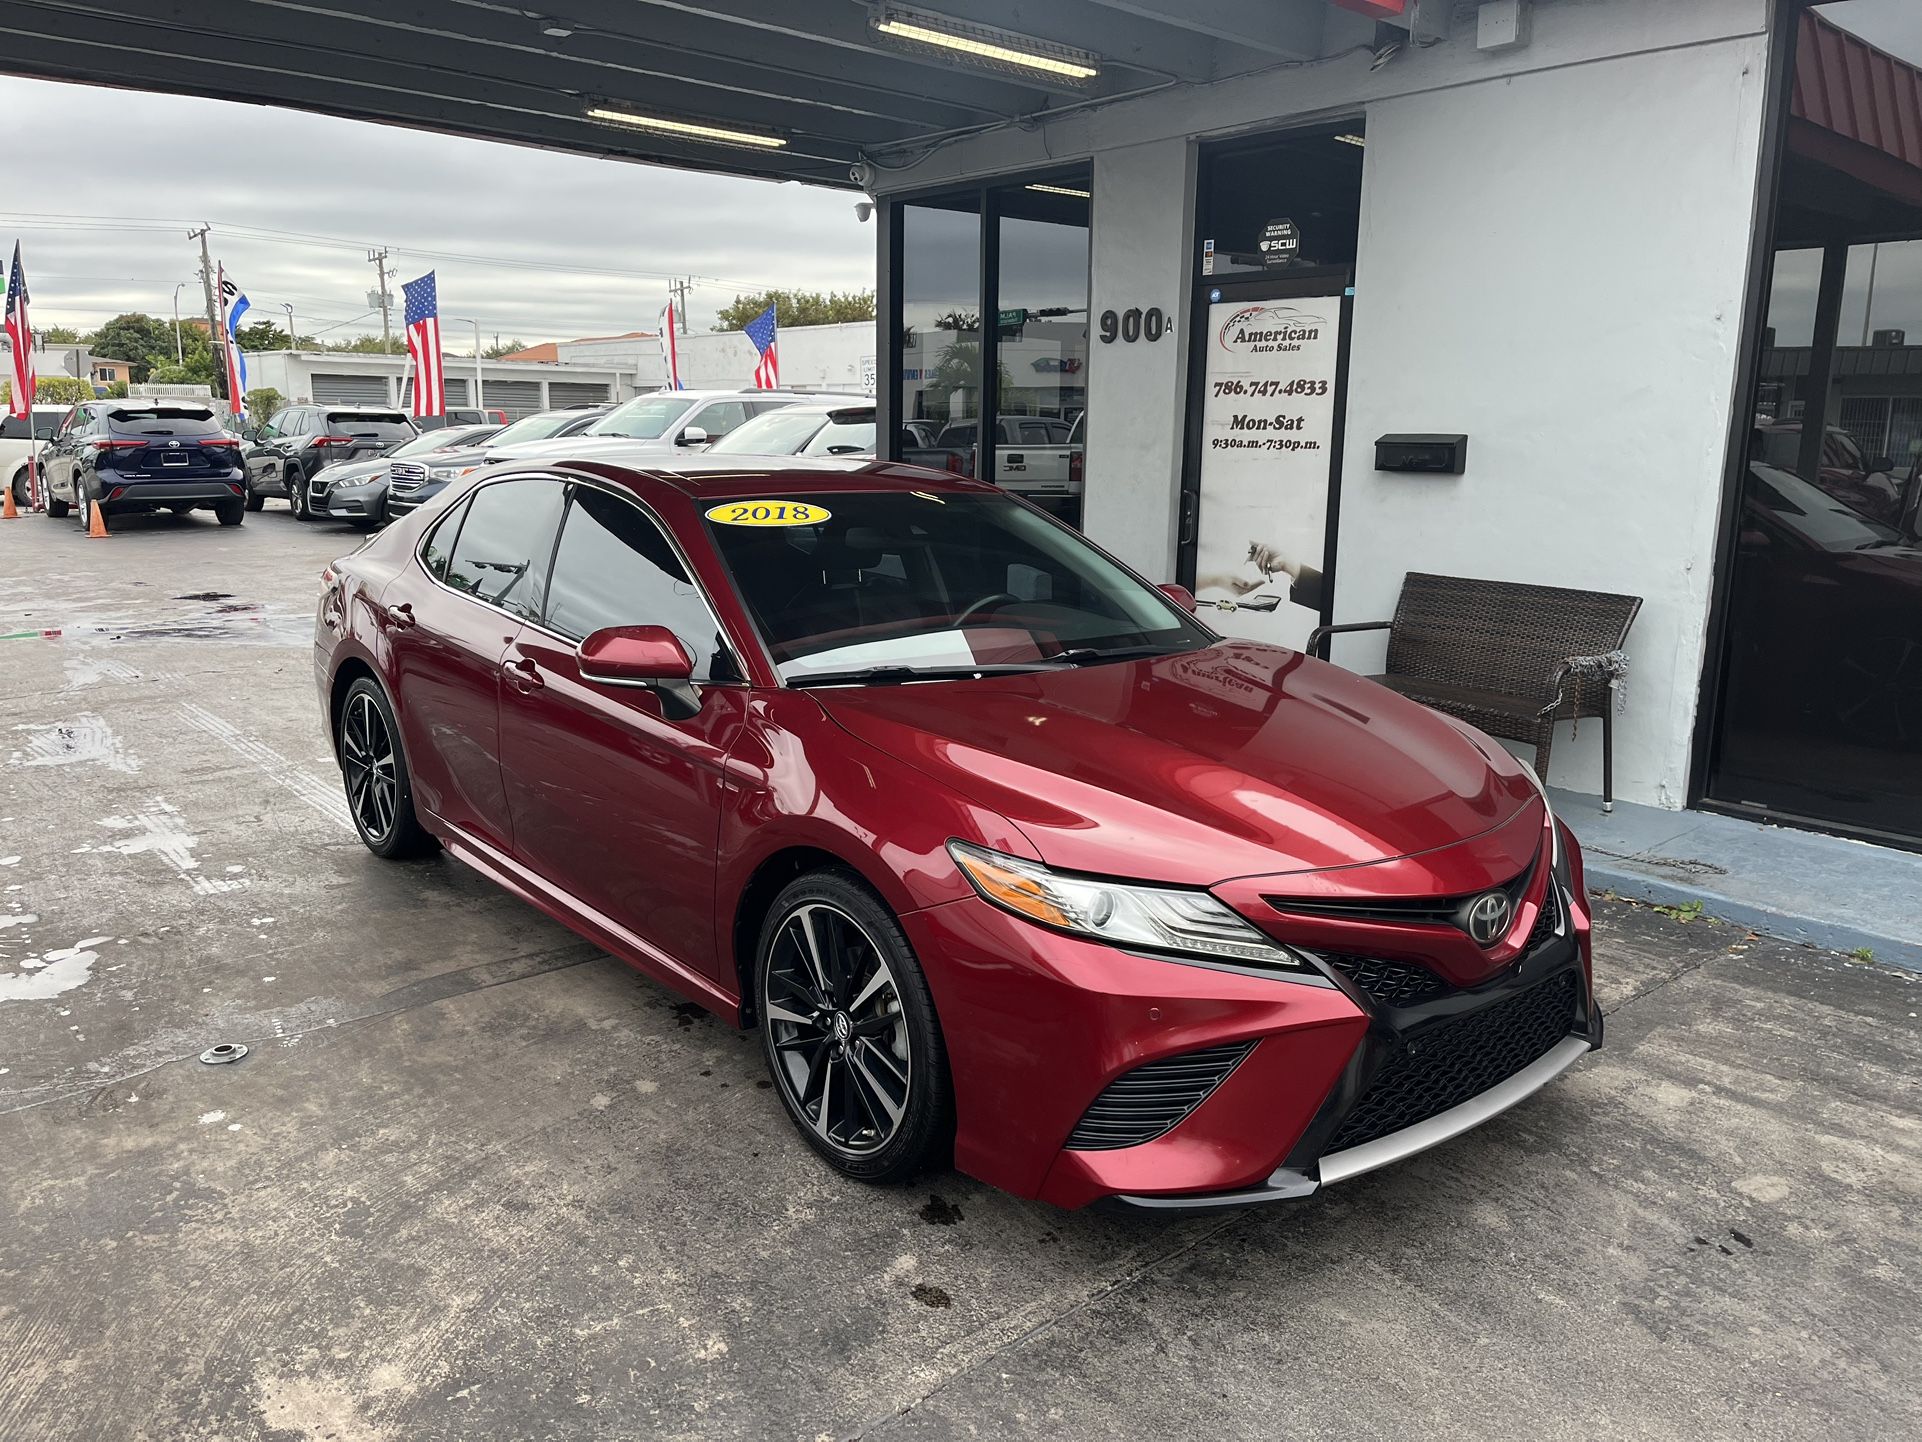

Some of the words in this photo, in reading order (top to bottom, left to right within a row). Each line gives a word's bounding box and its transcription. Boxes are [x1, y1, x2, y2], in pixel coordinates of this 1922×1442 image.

[1265, 229, 1291, 237] WARNING
[1270, 239, 1297, 250] SCW
[1099, 307, 1163, 344] 900
[1164, 316, 1174, 333] A
[1233, 326, 1319, 343] American
[1250, 344, 1274, 353] Auto
[1276, 343, 1301, 352] Sales
[864, 373, 876, 386] 35
[1213, 379, 1328, 398] 786.747.4833
[1230, 414, 1305, 431] Mon-Sat
[1211, 438, 1320, 451] 9:30a.m.-7:30p.m.
[731, 506, 810, 521] 2018
